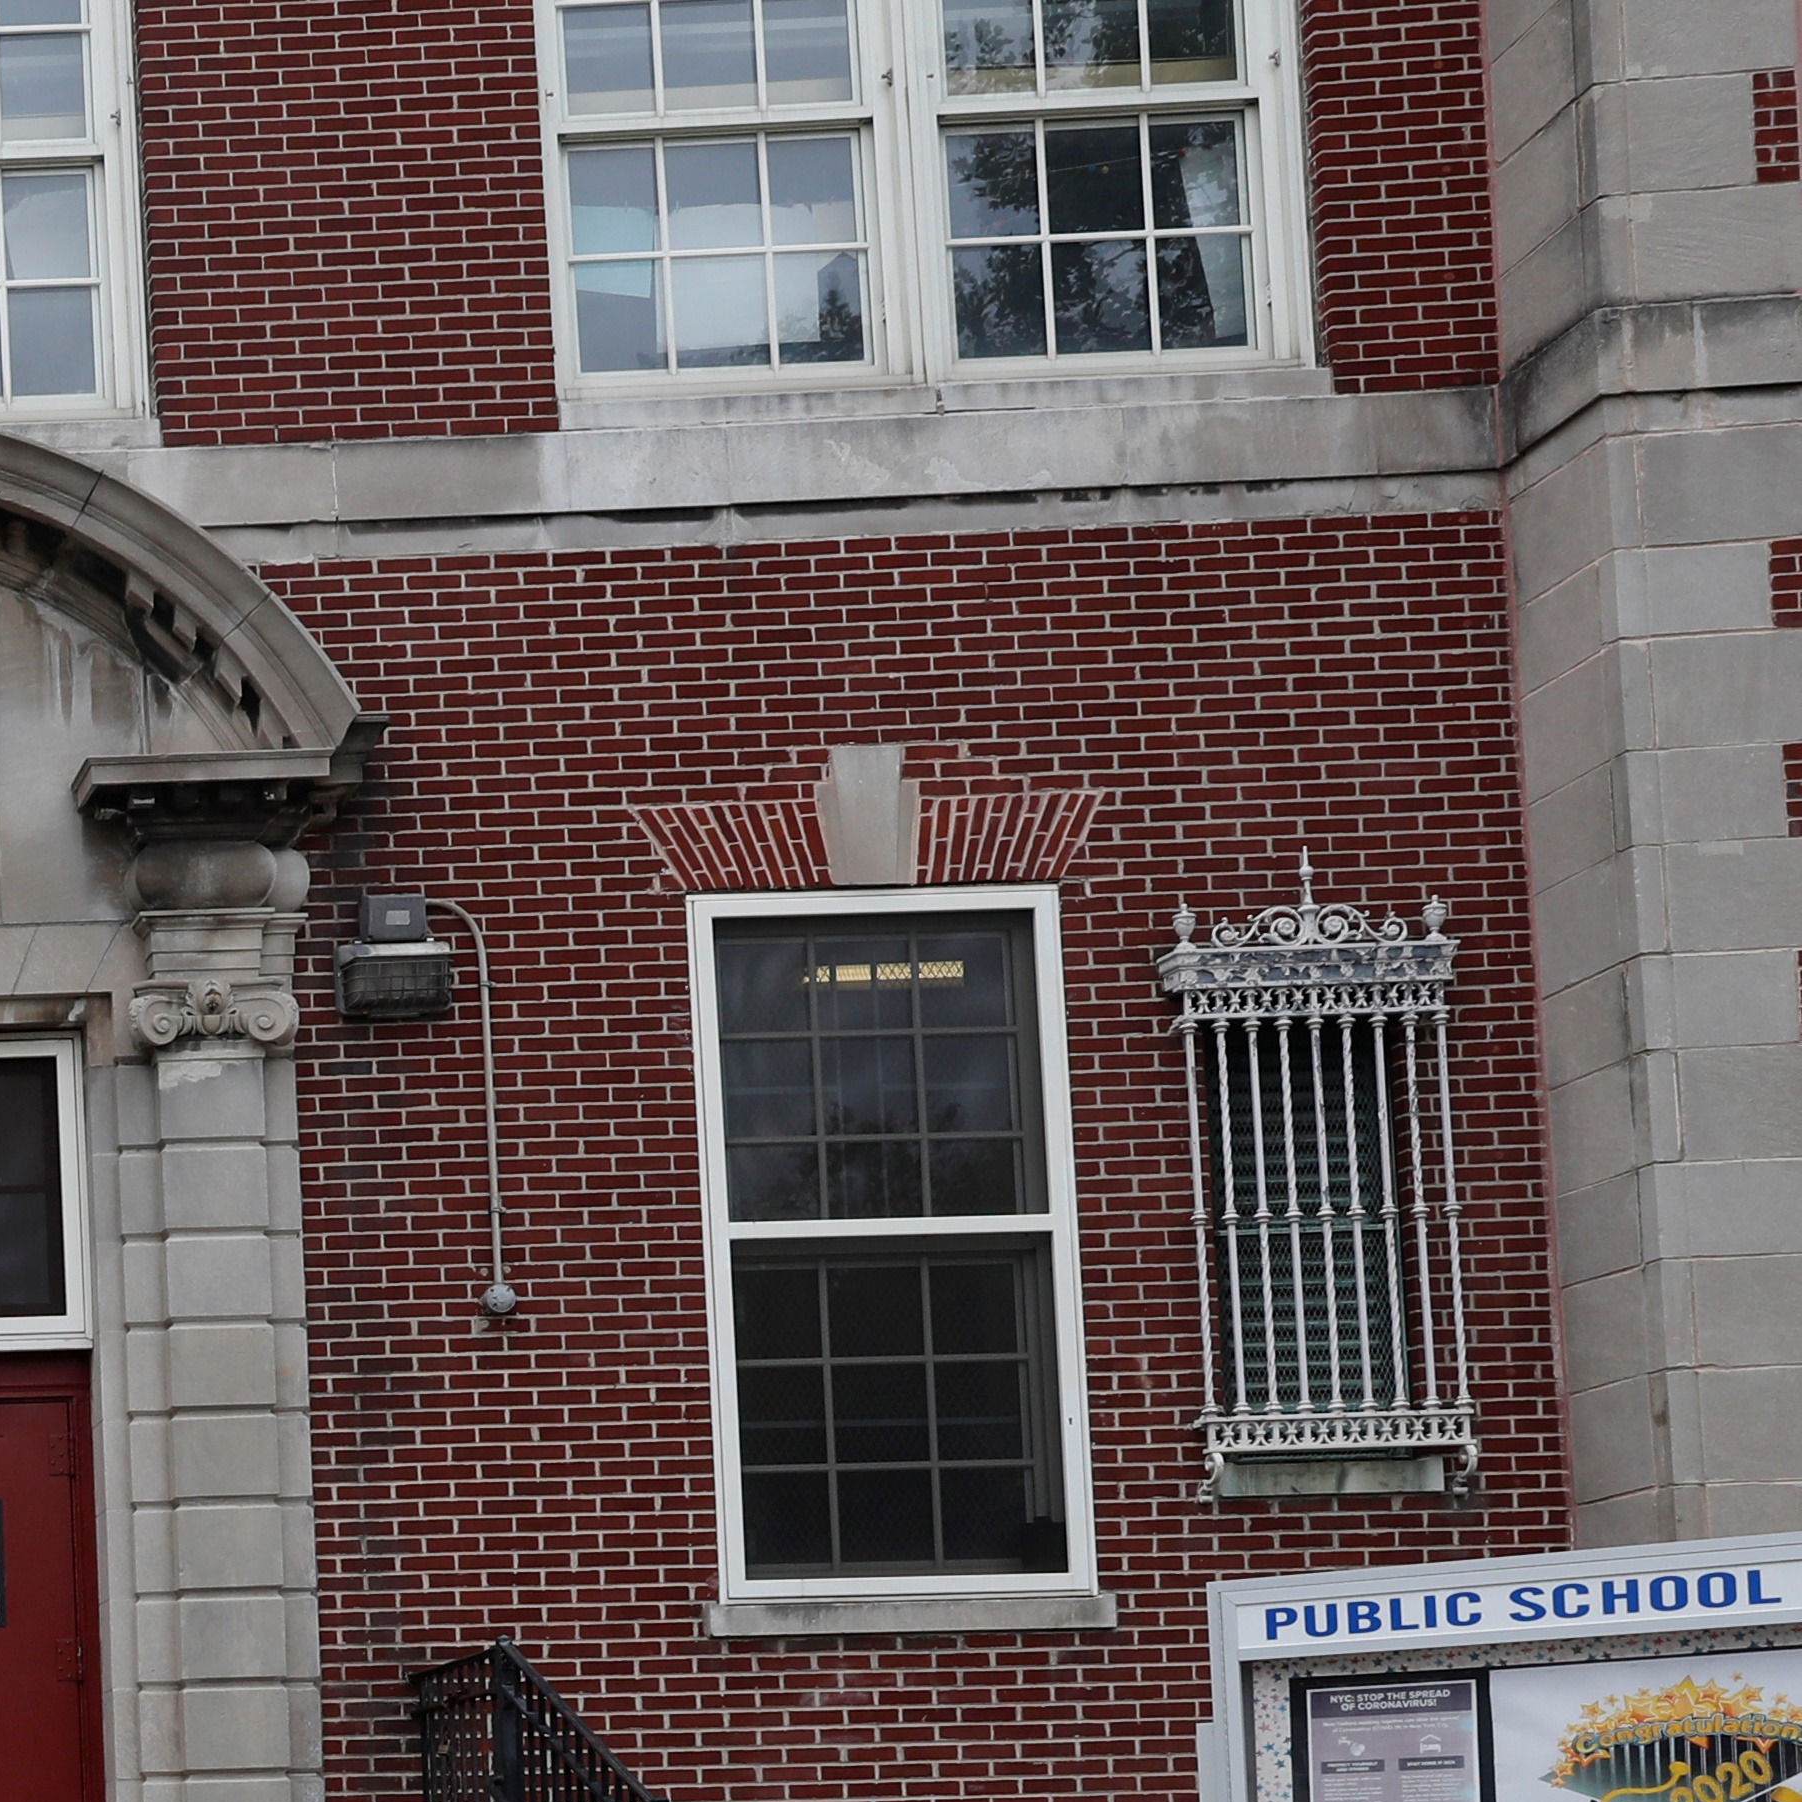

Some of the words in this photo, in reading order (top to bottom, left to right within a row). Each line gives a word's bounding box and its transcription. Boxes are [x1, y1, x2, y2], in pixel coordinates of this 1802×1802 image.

[1263, 1590, 1482, 1641] PUBLIC
[1508, 1569, 1782, 1623] SCHOOL
[1329, 1694, 1355, 1704] NYC:
[1356, 1693, 1385, 1702] STOP
[1386, 1691, 1407, 1701] THE
[1408, 1689, 1451, 1699] SPREAD
[1340, 1703, 1355, 1711] OF
[1357, 1698, 1437, 1711] CORONAVIRUS!
[1574, 1713, 1802, 1753] Congratulation
